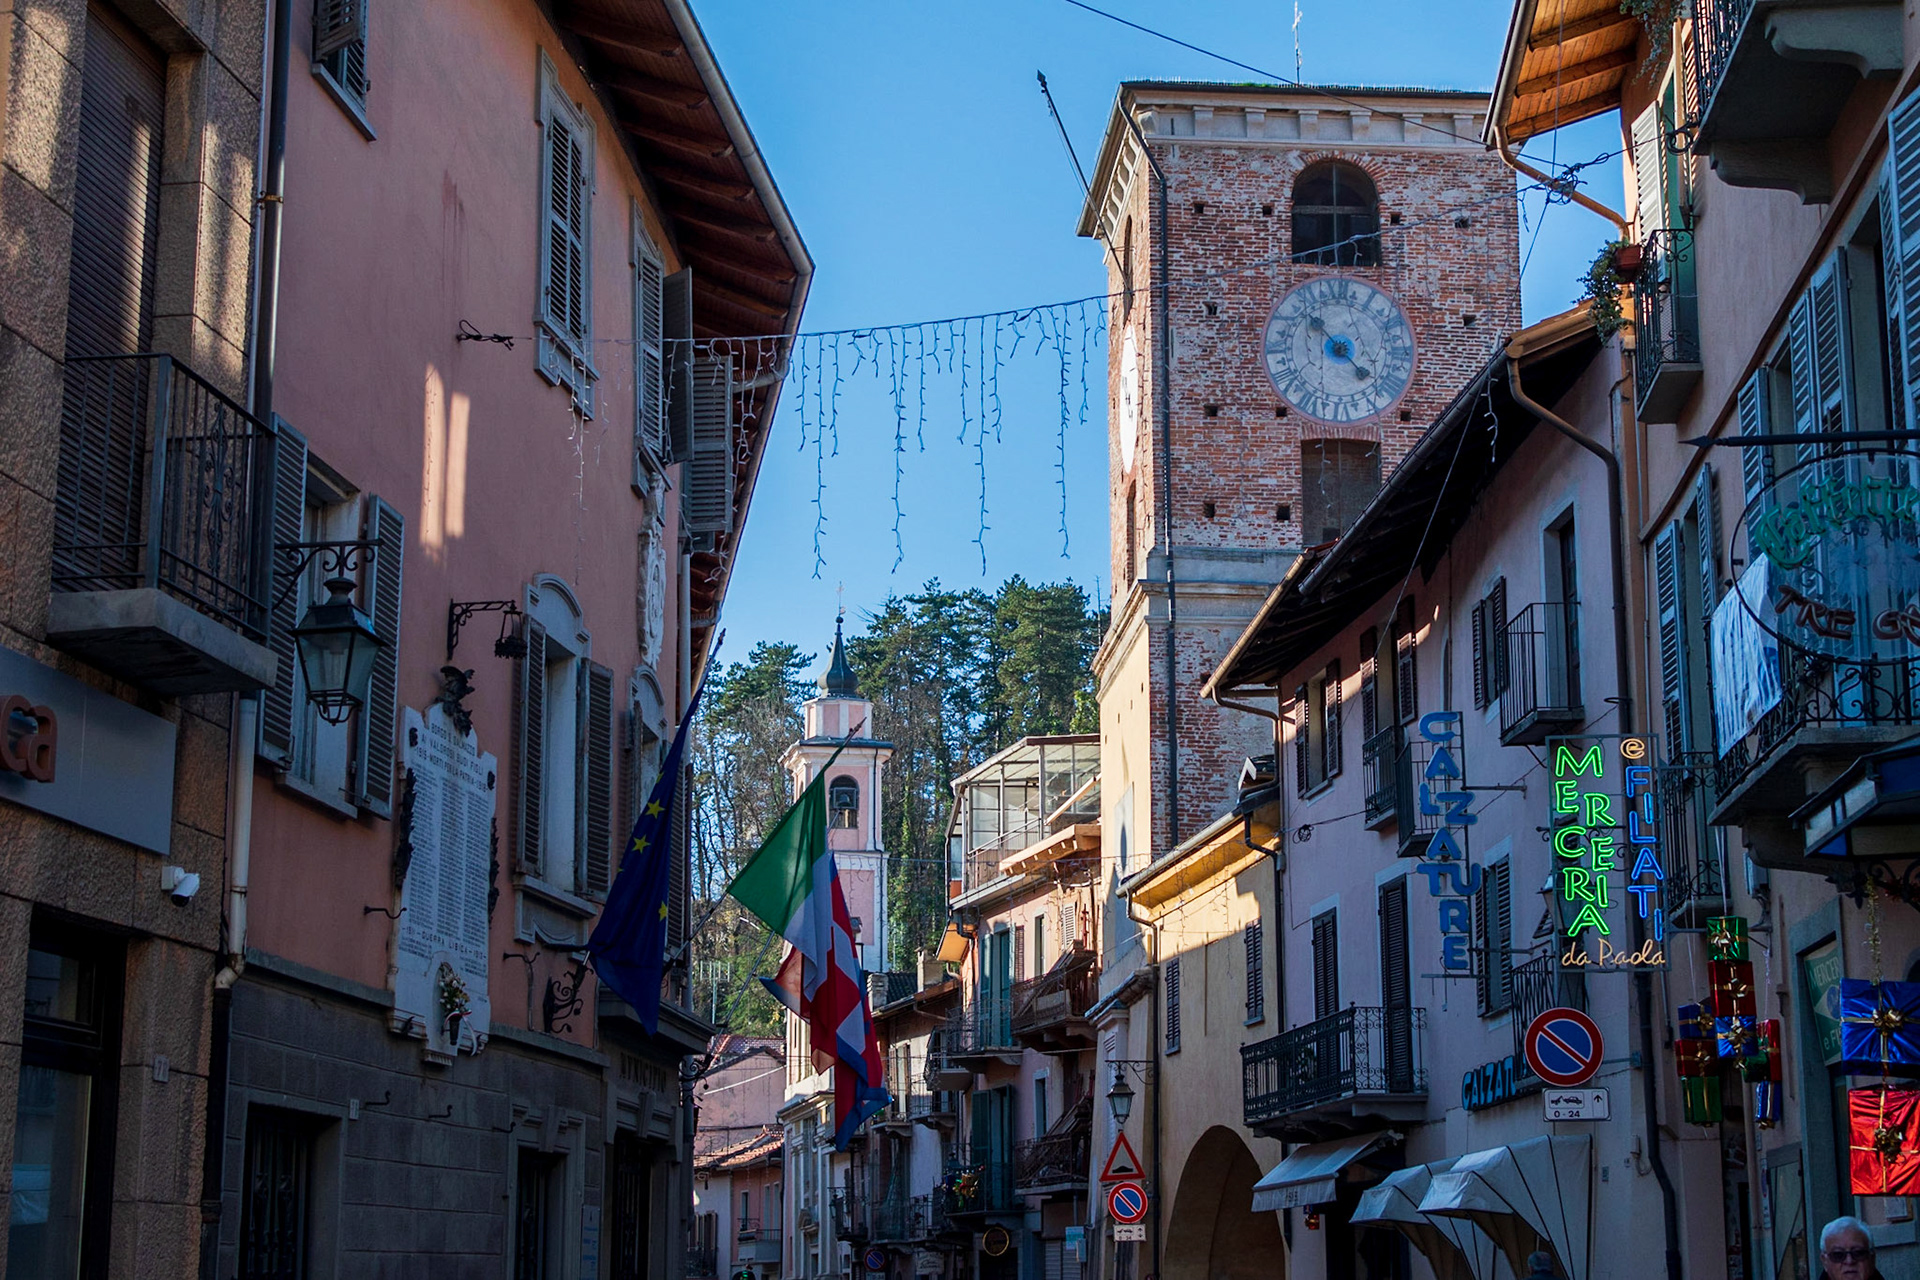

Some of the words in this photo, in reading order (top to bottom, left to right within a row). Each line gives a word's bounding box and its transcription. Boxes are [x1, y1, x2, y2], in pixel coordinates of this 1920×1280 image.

[1775, 584, 1857, 641] TRE
[1620, 737, 1645, 760] e
[1416, 711, 1482, 970] CALZATURE
[1554, 744, 1616, 938] MERCERIA
[1624, 765, 1664, 942] FILATI
[1561, 941, 1592, 967] da
[1596, 937, 1666, 967] Paola
[1568, 1110, 1581, 1118] 24
